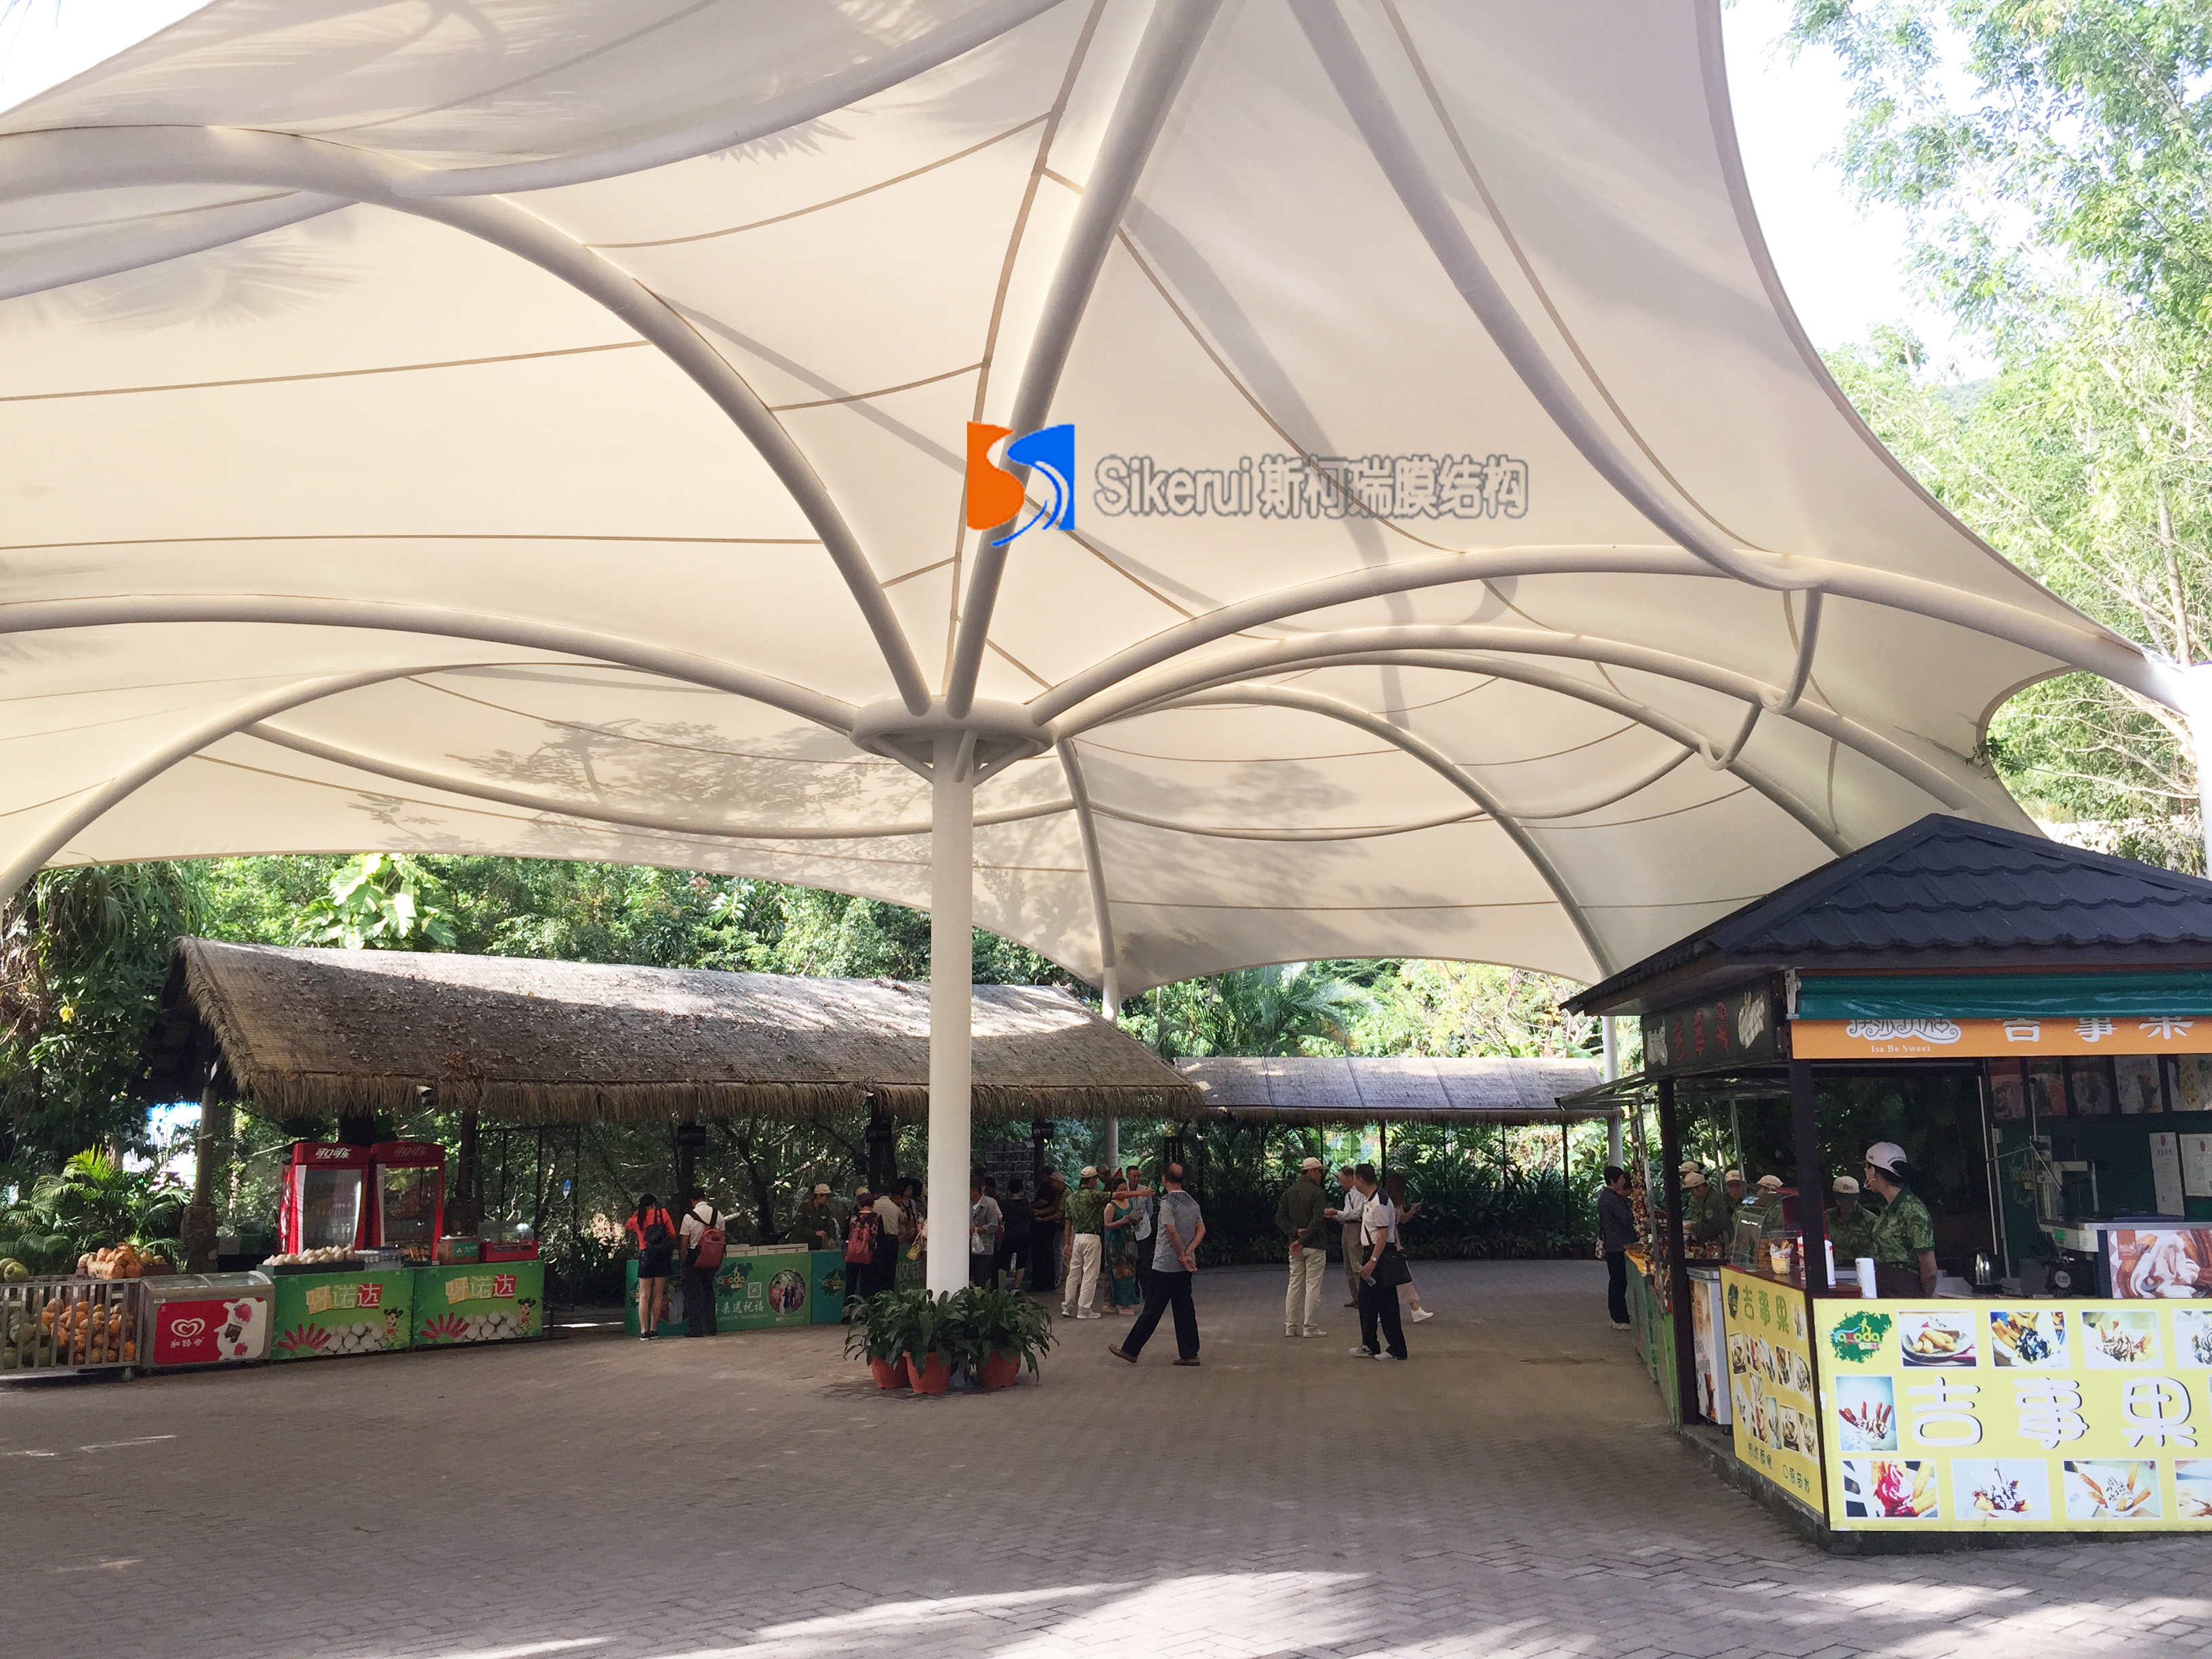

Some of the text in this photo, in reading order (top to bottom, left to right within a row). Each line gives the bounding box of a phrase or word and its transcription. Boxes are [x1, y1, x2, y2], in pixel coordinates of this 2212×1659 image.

[1870, 1044, 1931, 1052] Isa Be Sweet
[306, 1283, 382, 1314] 呀诺达
[445, 1274, 516, 1304] 呀诺达
[1742, 1285, 1790, 1334] 吉事果
[1906, 1376, 2198, 1448] 吉事果
